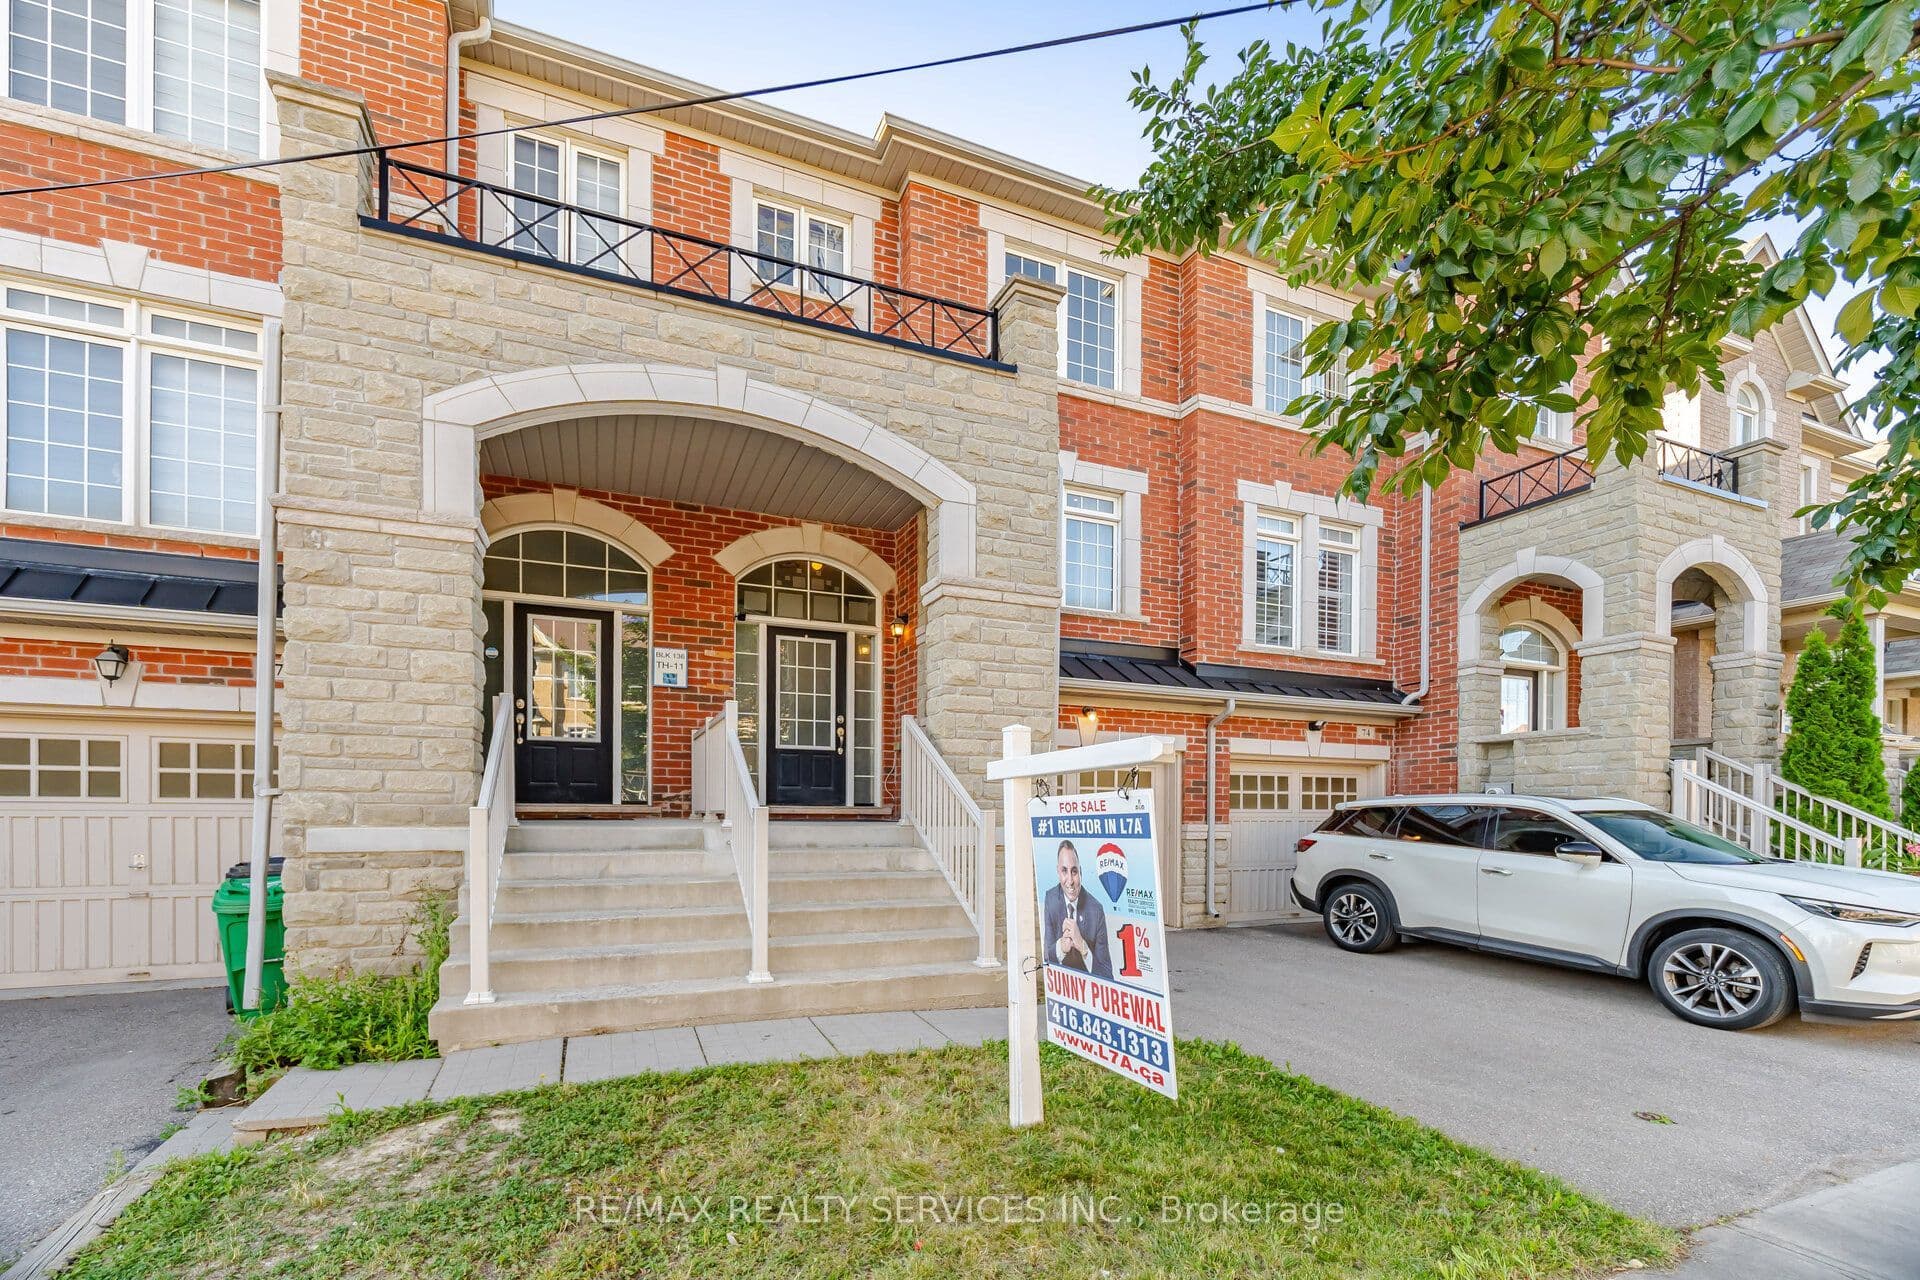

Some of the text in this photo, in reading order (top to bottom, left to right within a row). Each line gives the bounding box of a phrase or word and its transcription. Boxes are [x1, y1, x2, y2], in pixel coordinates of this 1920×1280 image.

[656, 661, 684, 670] TH-11
[1059, 800, 1107, 814] FOR SALE
[1038, 817, 1143, 836] #1 REALTOR IN L7A
[1099, 858, 1125, 870] RE/MAX
[1126, 887, 1154, 900] RE/MAX
[1116, 923, 1150, 977] 1%
[1046, 967, 1166, 1034] SUNNY PUREWAL
[1051, 1001, 1164, 1067] 416.843.1313
[1053, 1027, 1165, 1087] www.L7A.ca
